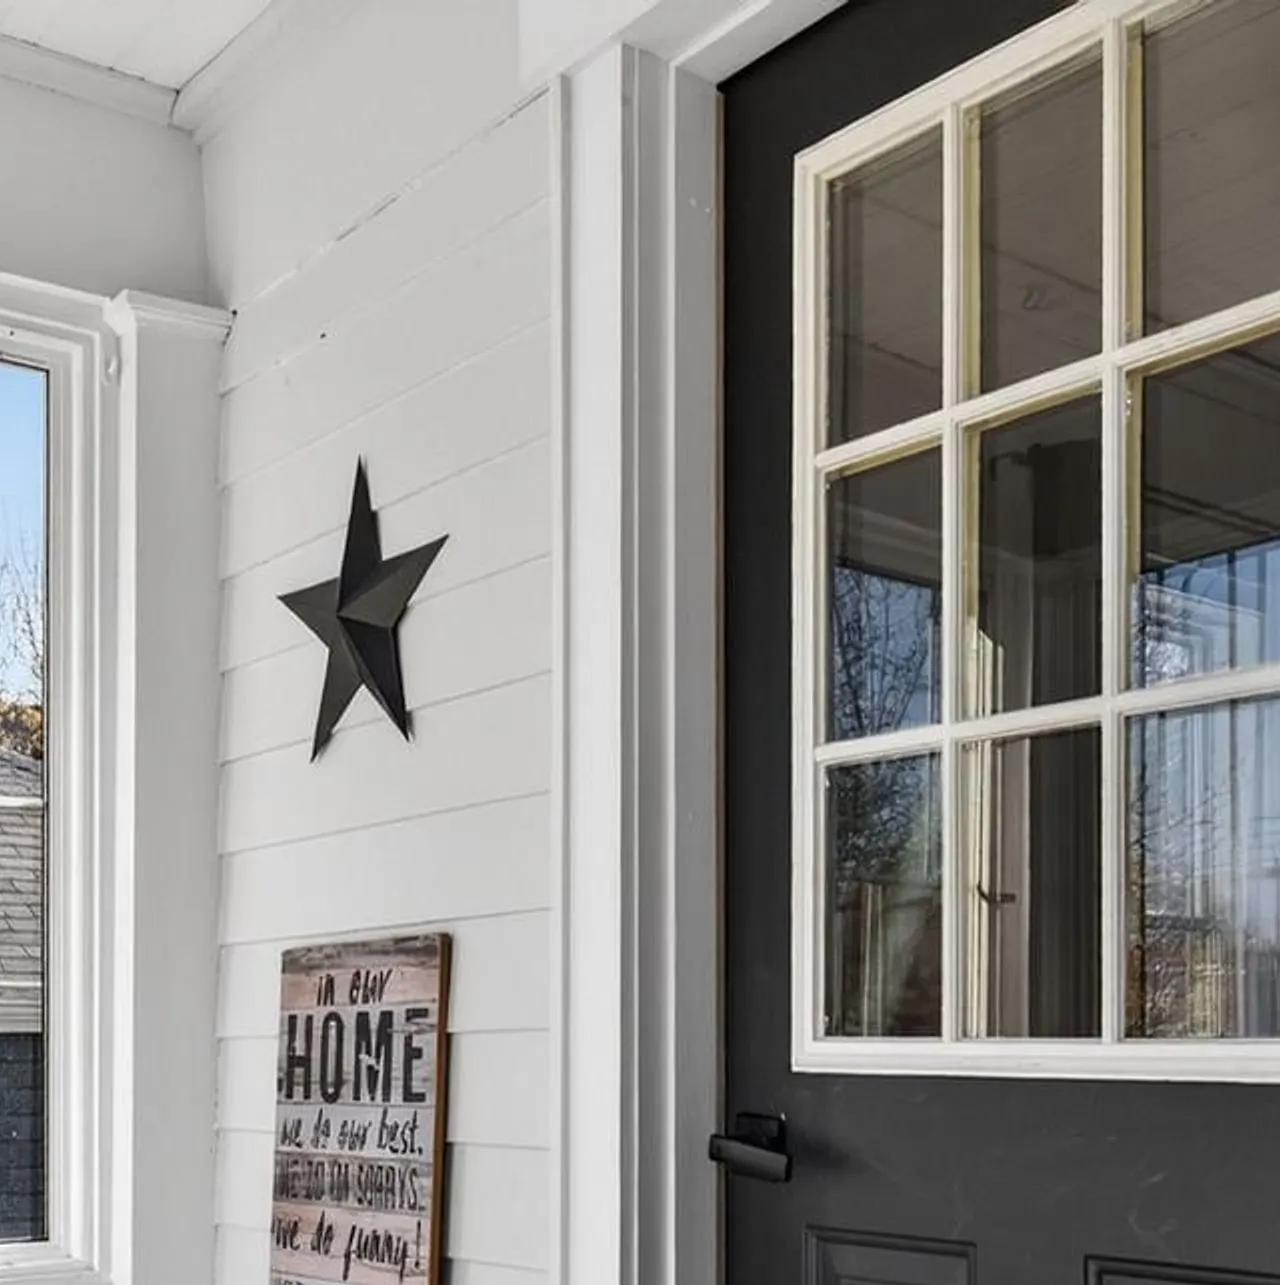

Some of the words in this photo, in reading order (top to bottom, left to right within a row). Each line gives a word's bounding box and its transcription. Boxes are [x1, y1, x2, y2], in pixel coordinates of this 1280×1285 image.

[317, 974, 336, 1007] in
[285, 1007, 429, 1103] HOME
[280, 1116, 303, 1148] we
[311, 1107, 331, 1147] do
[377, 1106, 424, 1155] best.
[310, 1209, 335, 1255] do
